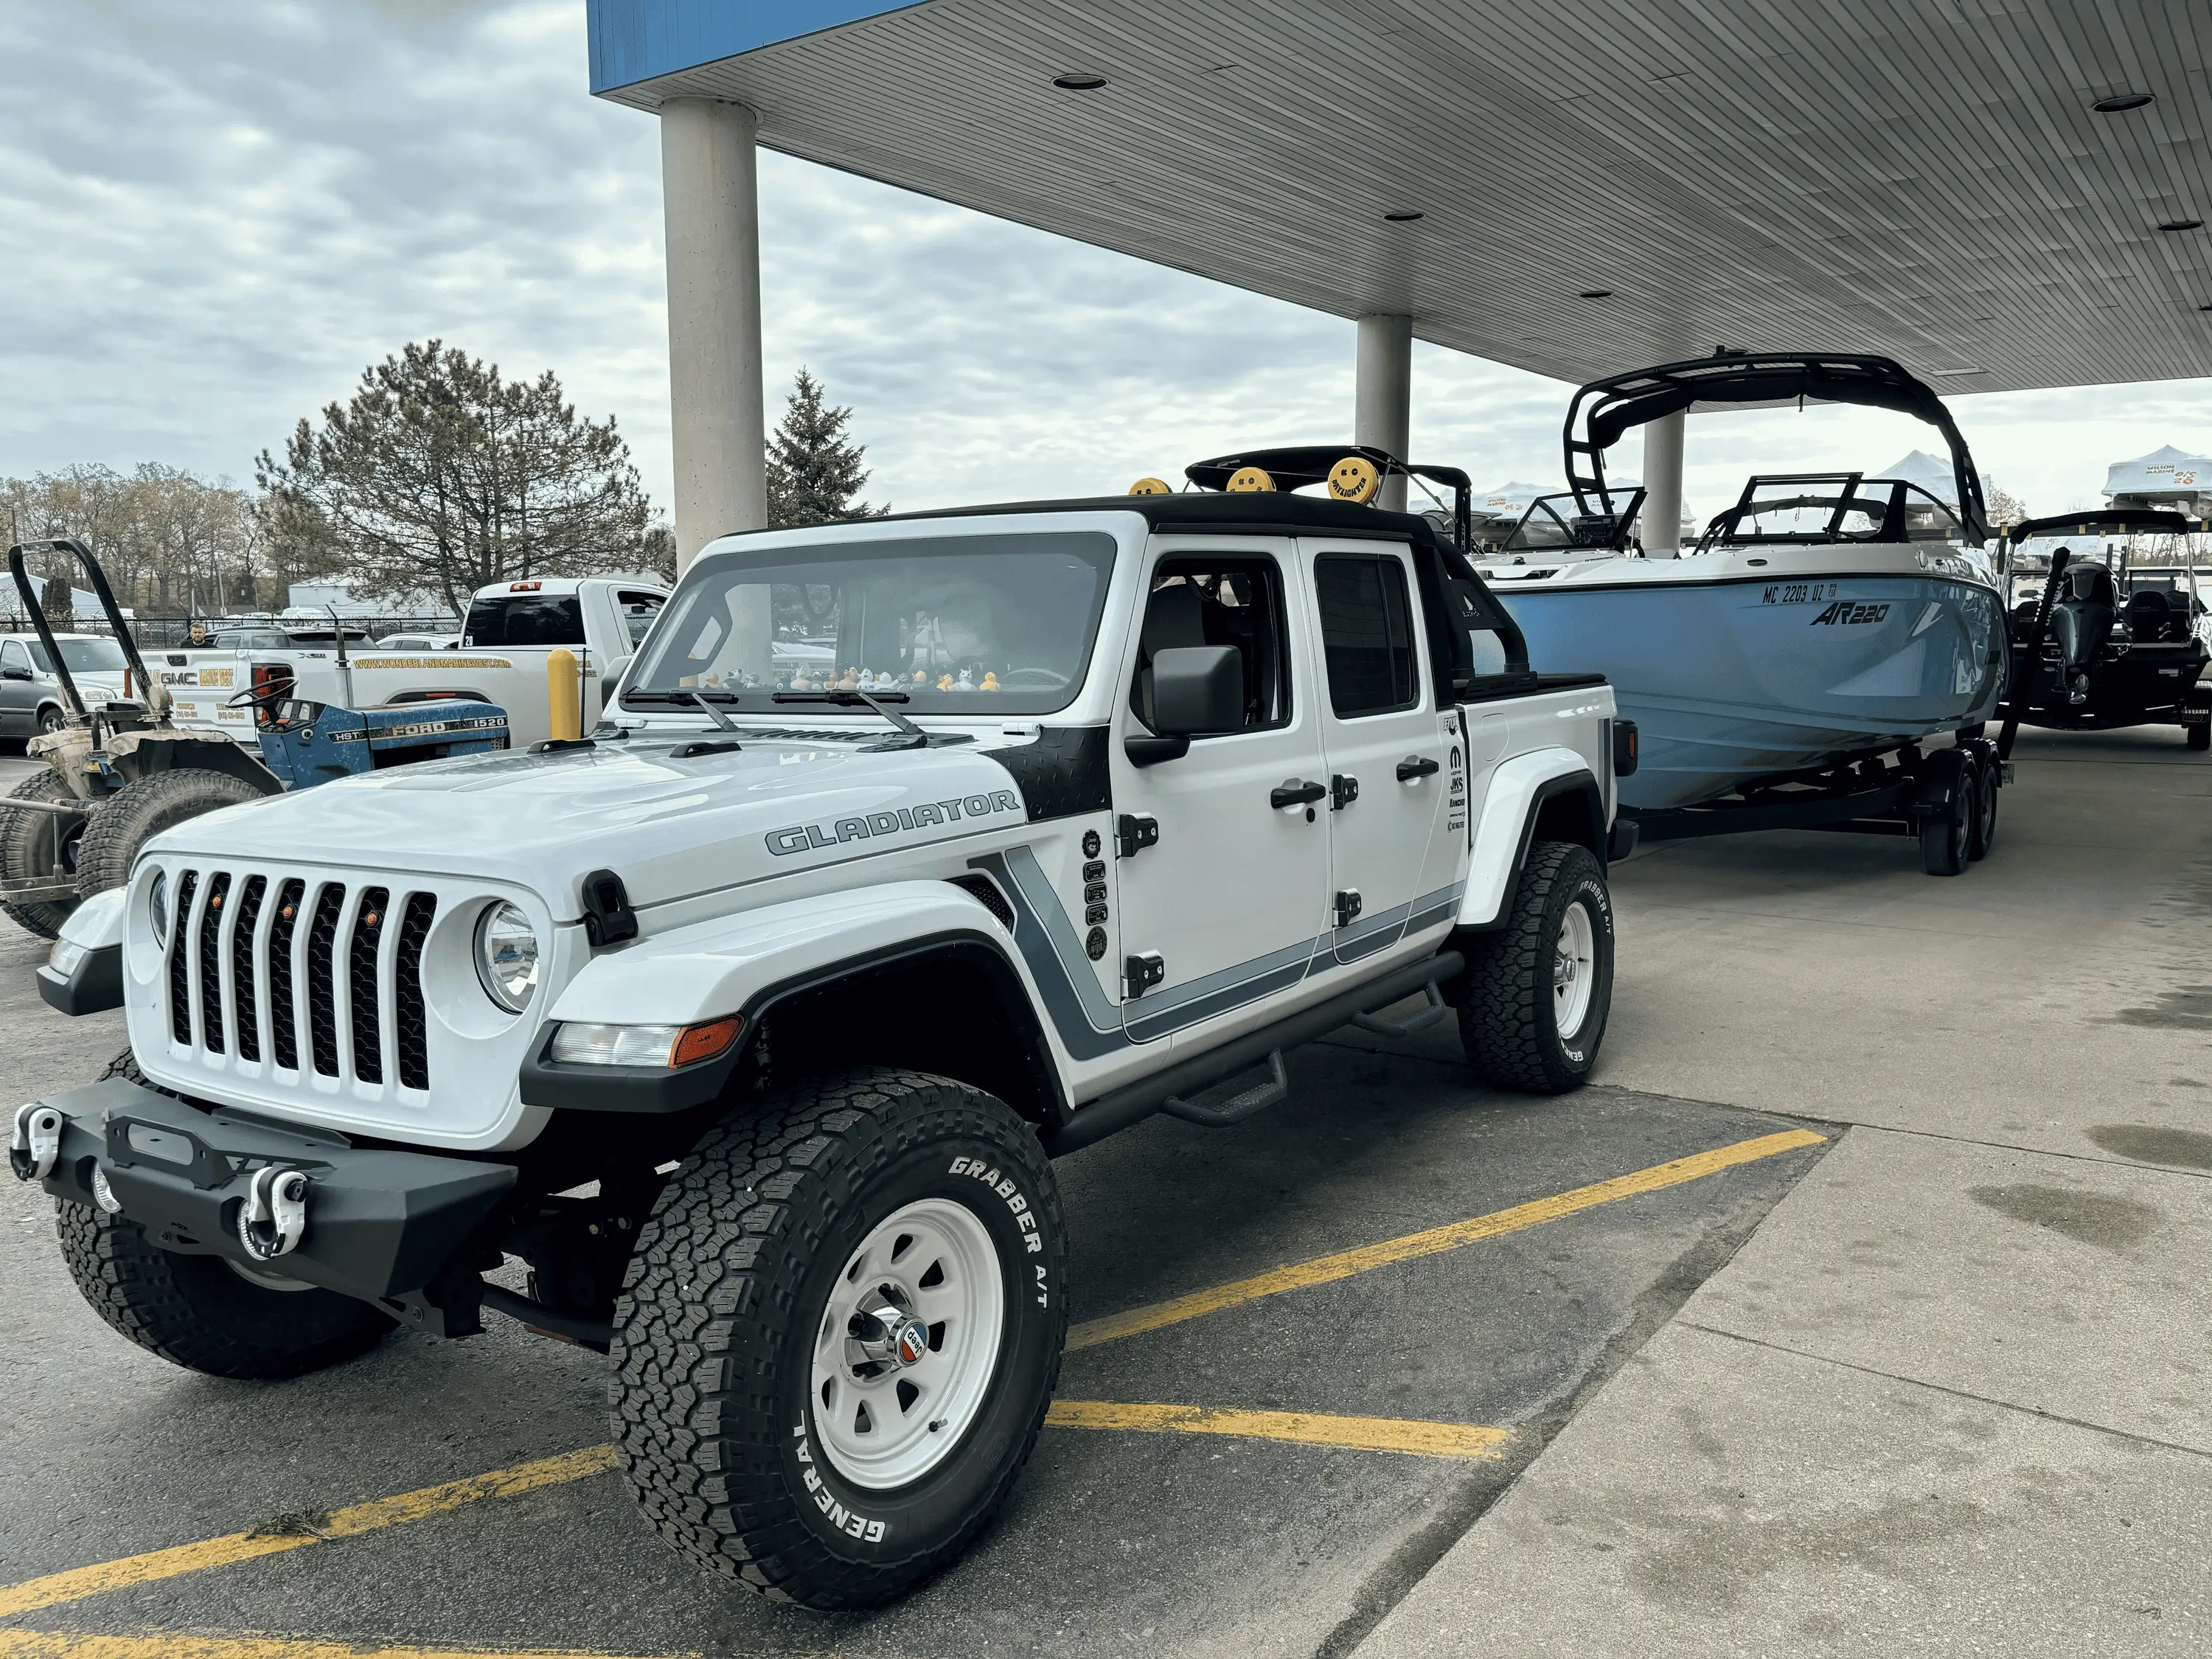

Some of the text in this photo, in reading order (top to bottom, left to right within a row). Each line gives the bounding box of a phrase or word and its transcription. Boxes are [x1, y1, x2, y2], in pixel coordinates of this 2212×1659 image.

[1332, 477, 1366, 498] DAYLIGHTER
[1762, 586, 1779, 604] MC
[1782, 585, 1808, 603] 2203
[1809, 602, 1891, 625] AR220
[465, 636, 473, 647] 20
[355, 658, 512, 669] WWW.WONDERLANDMARINEWEST.COM
[161, 672, 198, 686] GMC
[392, 723, 446, 737] FORD
[474, 718, 505, 728] 1520
[335, 732, 359, 741] HST
[1450, 776, 1463, 793] JKS
[765, 790, 1020, 856] GLADIATOR
[1579, 880, 1607, 912] GRABBER
[948, 1156, 1048, 1308] GRABBER A/T
[908, 1331, 922, 1354] Jeep
[793, 1410, 886, 1543] GENERAL
